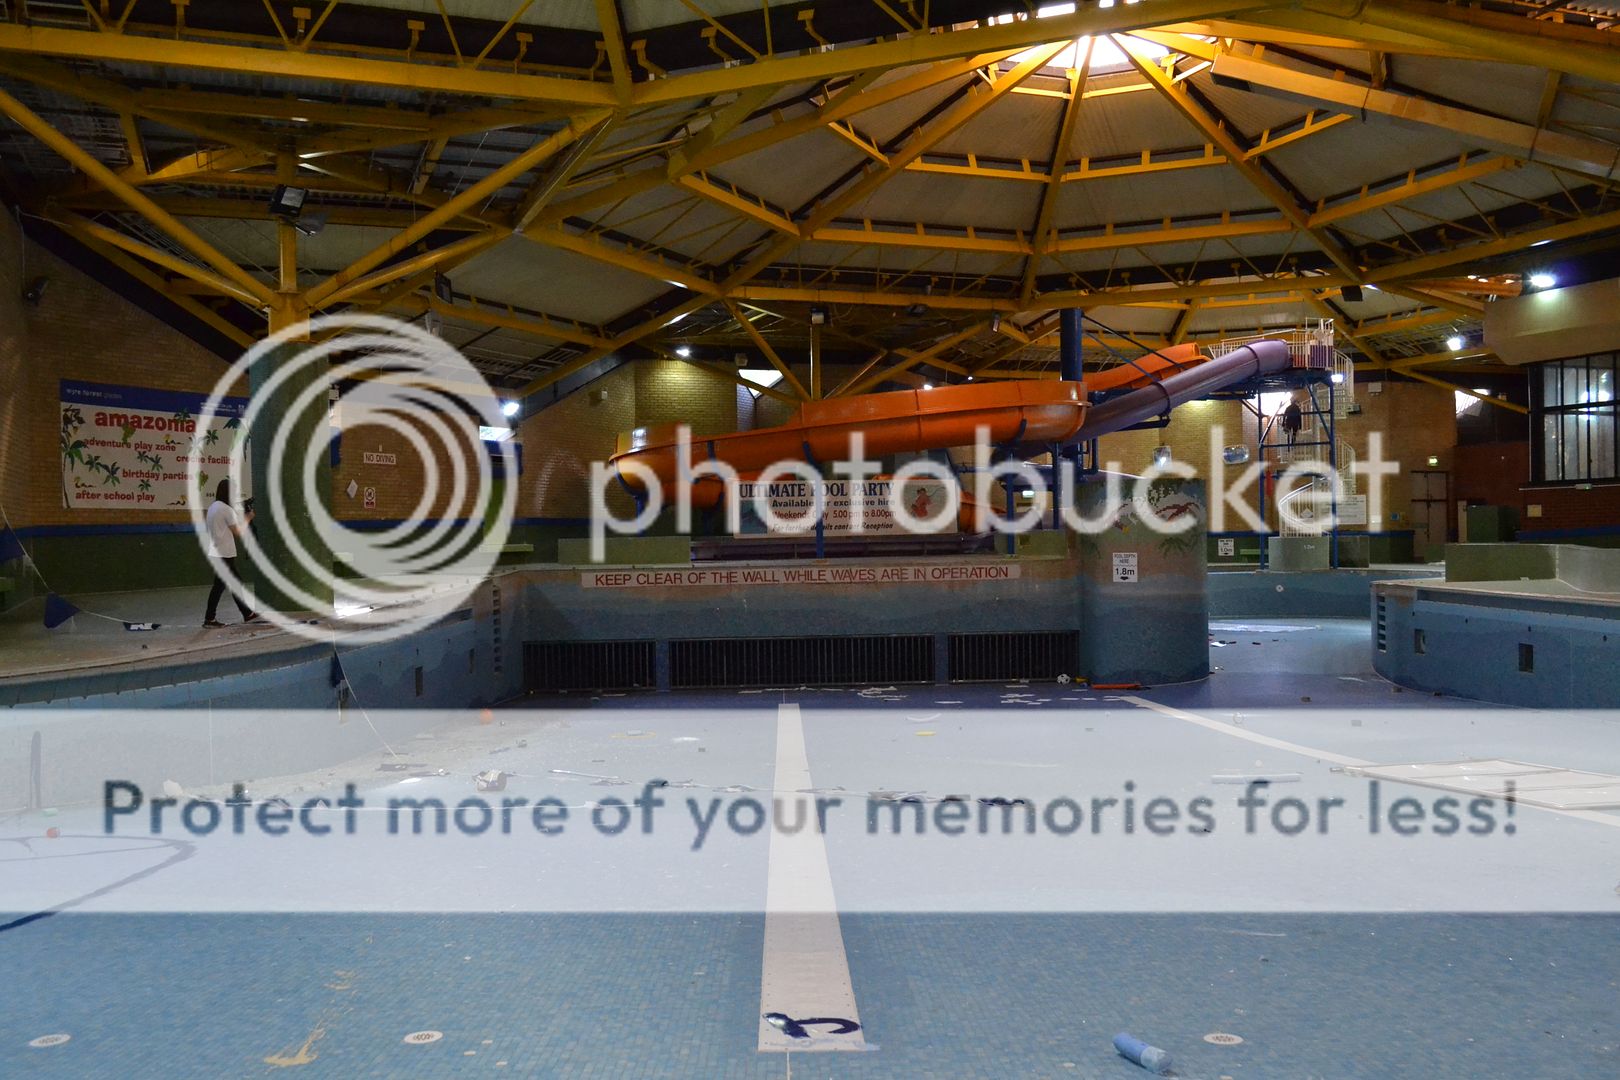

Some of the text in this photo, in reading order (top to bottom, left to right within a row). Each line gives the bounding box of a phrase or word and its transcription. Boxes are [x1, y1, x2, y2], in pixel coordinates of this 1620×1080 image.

[95, 411, 196, 433] amazonia
[84, 437, 176, 452] adventure play zone
[122, 469, 160, 481] birthday
[75, 491, 155, 502] after school play
[739, 483, 806, 498] ULTIMATE
[852, 482, 894, 497] PARTY
[772, 499, 814, 508] Available
[833, 498, 875, 507] exclusive
[877, 498, 895, 506] hire
[595, 566, 1009, 586] KEEP CLEAR OF THE WALL WHILE WAVES ARE IN OPERATION
[1115, 567, 1135, 576] 1.8m
